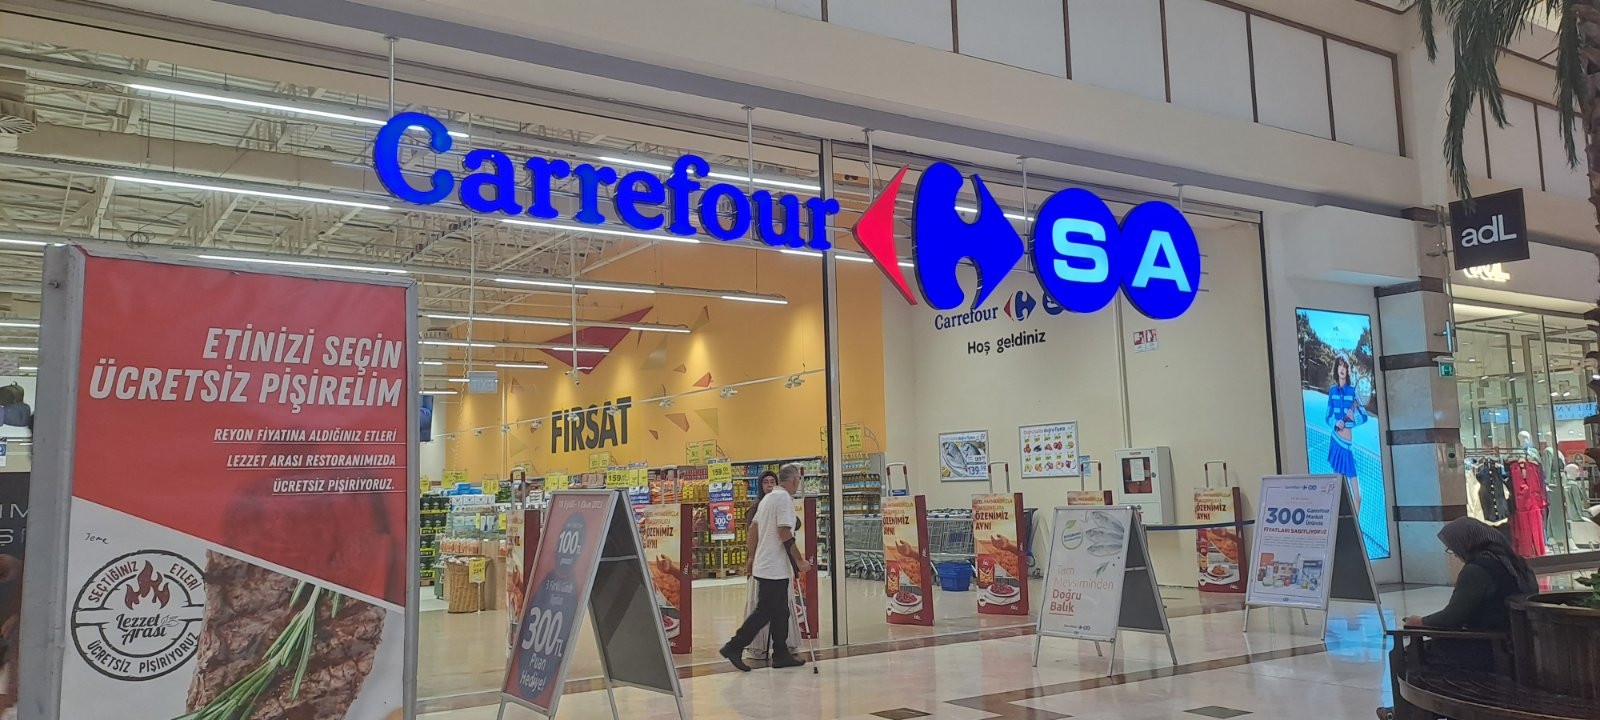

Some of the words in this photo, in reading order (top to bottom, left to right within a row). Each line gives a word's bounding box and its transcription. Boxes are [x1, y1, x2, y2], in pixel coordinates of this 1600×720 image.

[373, 112, 839, 250] Carrefour
[1461, 214, 1517, 248] adL
[934, 306, 999, 330] Carrefour
[203, 324, 314, 364] ETİNİZİ
[322, 333, 402, 376] SEÇİN
[968, 341, 990, 356] Hoş
[997, 329, 1046, 353] geldiniz
[89, 358, 250, 402] ÜCRETSİZ
[260, 368, 402, 413] PİŞİRELİM
[552, 396, 632, 453] FIRSAT
[214, 428, 253, 441] REYON
[257, 427, 305, 442] FİYATINA
[308, 428, 362, 442] ALDIĞINIZ
[364, 429, 397, 442] ETLERİ
[227, 455, 267, 467] LEZZET
[269, 455, 302, 467] ARASI
[306, 455, 396, 467] RESTORANIMIZDA
[273, 478, 324, 492] ÜCRETSİZ
[328, 477, 395, 494] PİŞİRİYORUZ.
[974, 510, 1009, 521] ÖZENİMİZ
[1196, 502, 1227, 512] ÖZENİMİZ
[1265, 507, 1306, 525] 300
[1196, 512, 1211, 521] AYNI
[975, 521, 992, 531] AYNI
[88, 561, 139, 603] SEÇTİĞİNİZ
[169, 563, 201, 590] ETLERİ
[1052, 588, 1082, 604] Doğru
[1050, 601, 1075, 614] Balık
[116, 614, 160, 632] Lezzet
[122, 626, 167, 645] Arası
[87, 640, 132, 673] ÜCRETSİZ
[139, 632, 199, 673] PİŞİRİYORUZ
[530, 653, 547, 671] Puan
